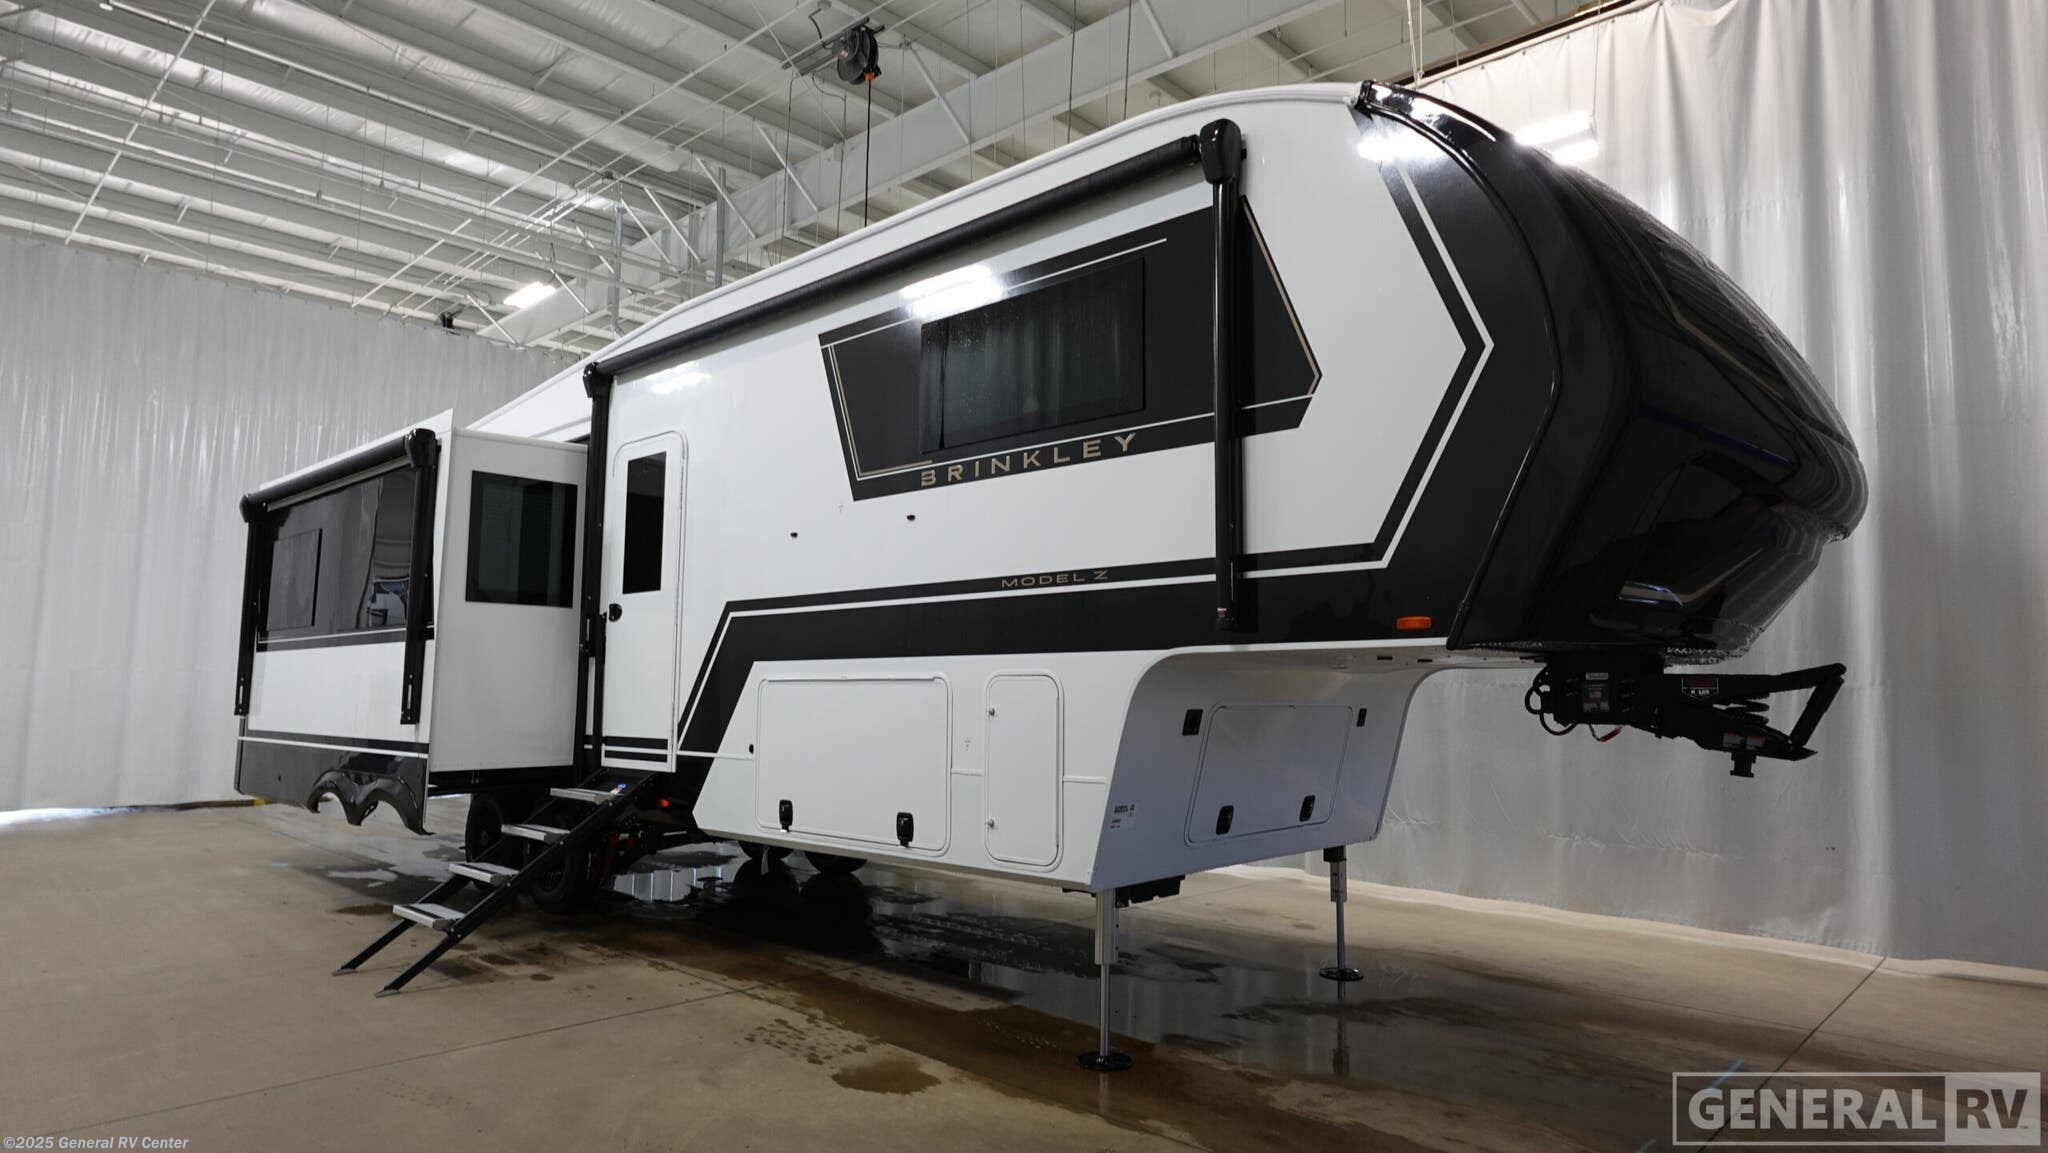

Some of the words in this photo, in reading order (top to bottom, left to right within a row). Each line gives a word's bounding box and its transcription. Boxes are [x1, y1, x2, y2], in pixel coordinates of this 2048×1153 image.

[921, 433, 1136, 487] BRINKLEY
[1001, 573, 1085, 588] MODEL
[1094, 570, 1108, 580] Z
